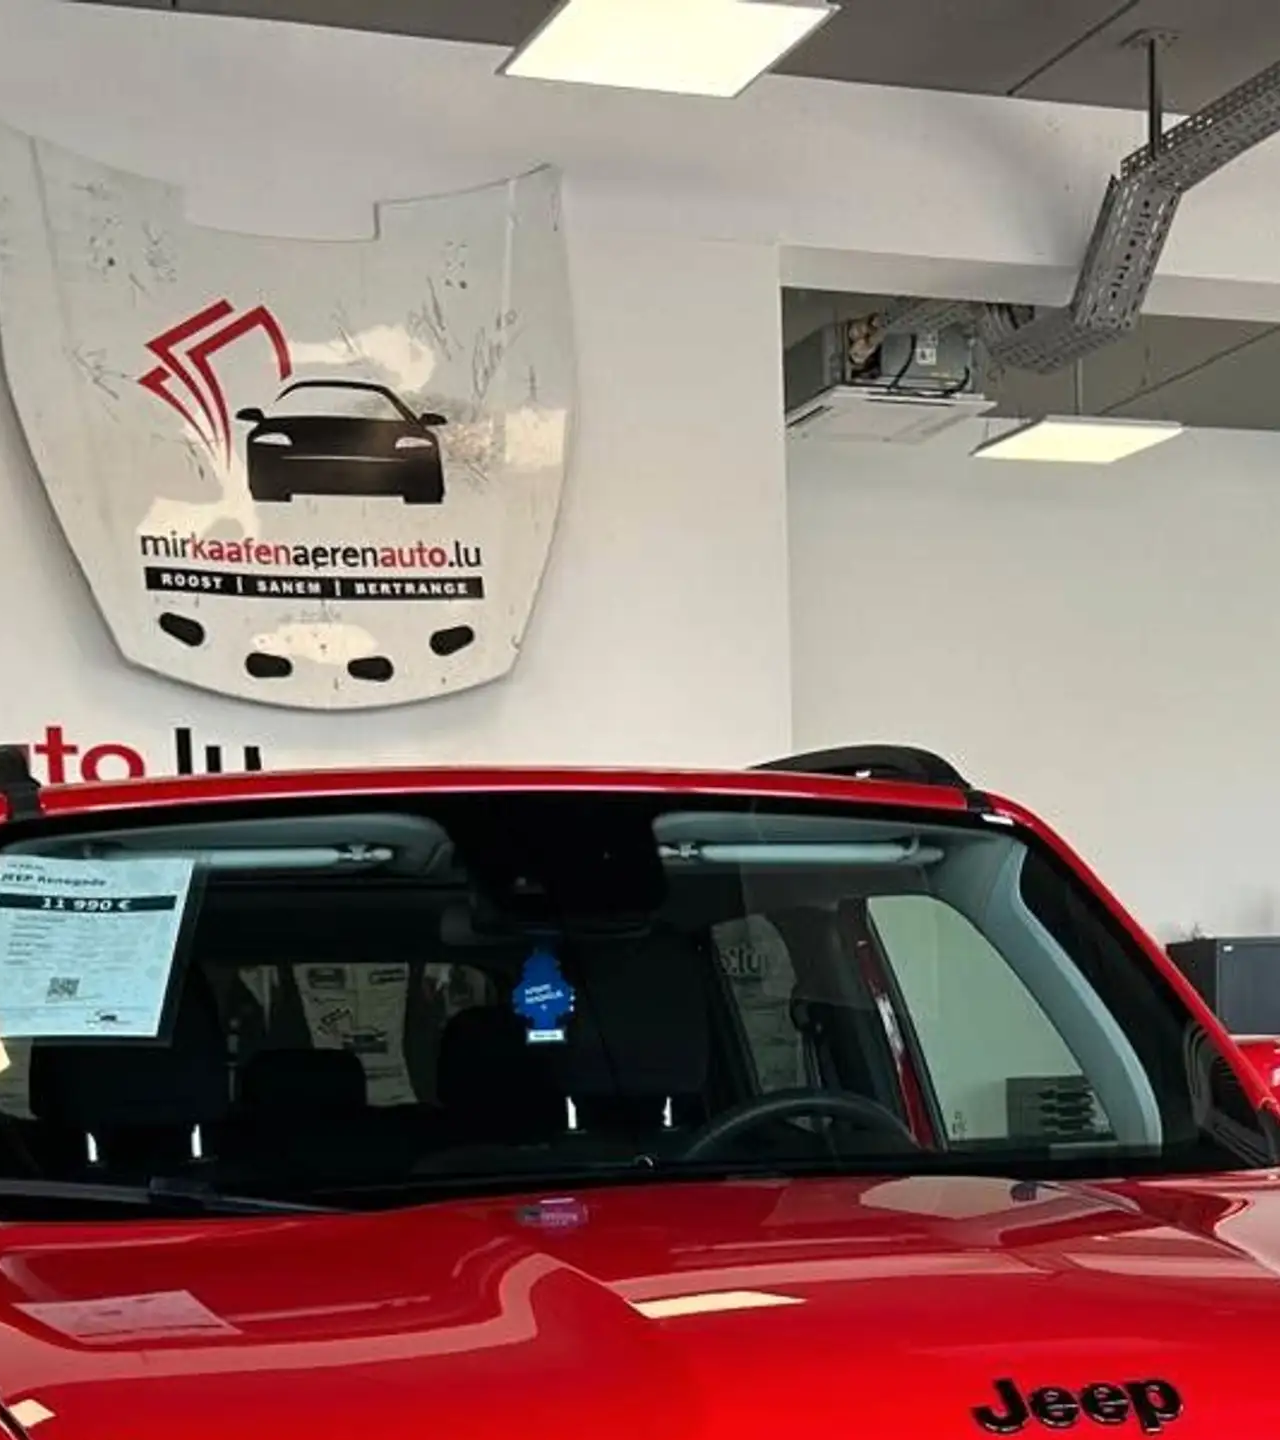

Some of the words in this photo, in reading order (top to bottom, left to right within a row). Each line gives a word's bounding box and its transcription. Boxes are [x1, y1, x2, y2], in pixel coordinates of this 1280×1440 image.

[140, 530, 482, 568] mirkaafenaerenauto.lu
[160, 573, 222, 589] ROOST
[257, 580, 321, 595] SANEM
[355, 582, 468, 595] BERTRANGE
[42, 897, 65, 909] 11
[971, 1377, 1183, 1435] Jeep
